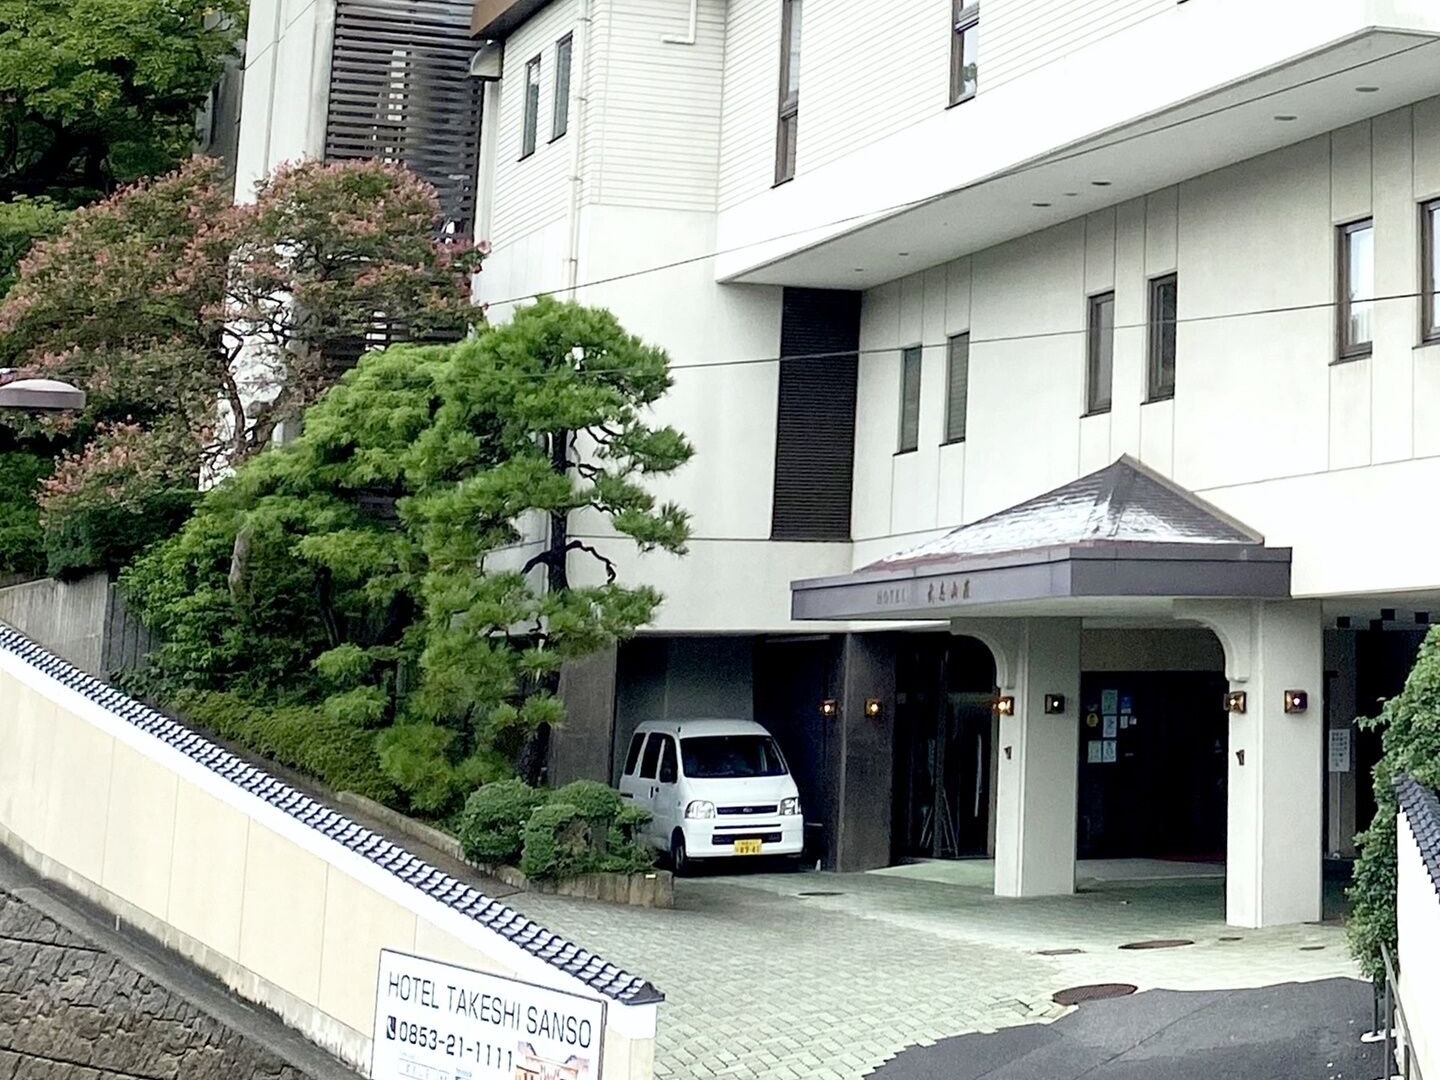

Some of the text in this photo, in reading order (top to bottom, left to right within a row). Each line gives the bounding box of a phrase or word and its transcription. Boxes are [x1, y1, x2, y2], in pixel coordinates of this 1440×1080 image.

[388, 971, 592, 1049] HOTEL TAKESHI SANSO
[398, 1020, 513, 1072] 0853-21-1111
